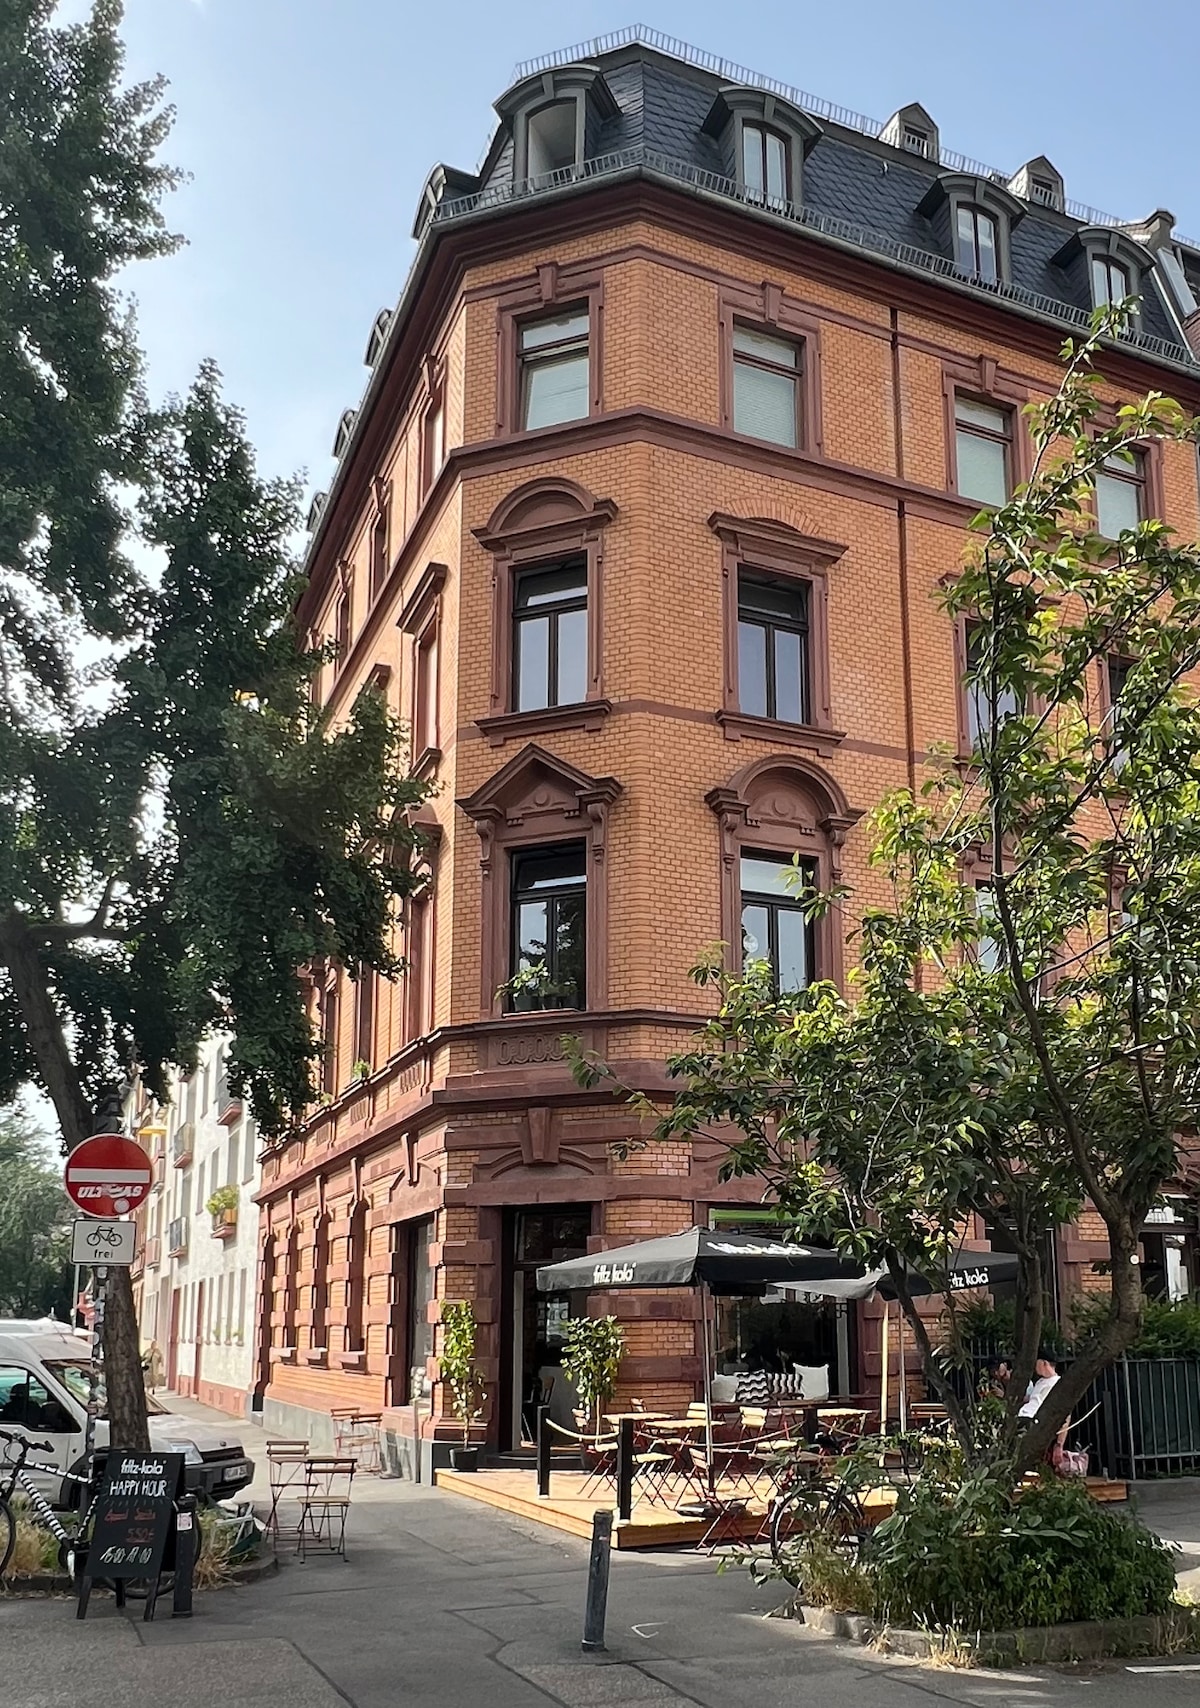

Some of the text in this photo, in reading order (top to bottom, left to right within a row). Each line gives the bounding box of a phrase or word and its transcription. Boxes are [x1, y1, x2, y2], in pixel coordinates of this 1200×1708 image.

[94, 1249, 114, 1258] frei
[109, 1480, 167, 1497] HAPPY HOUR
